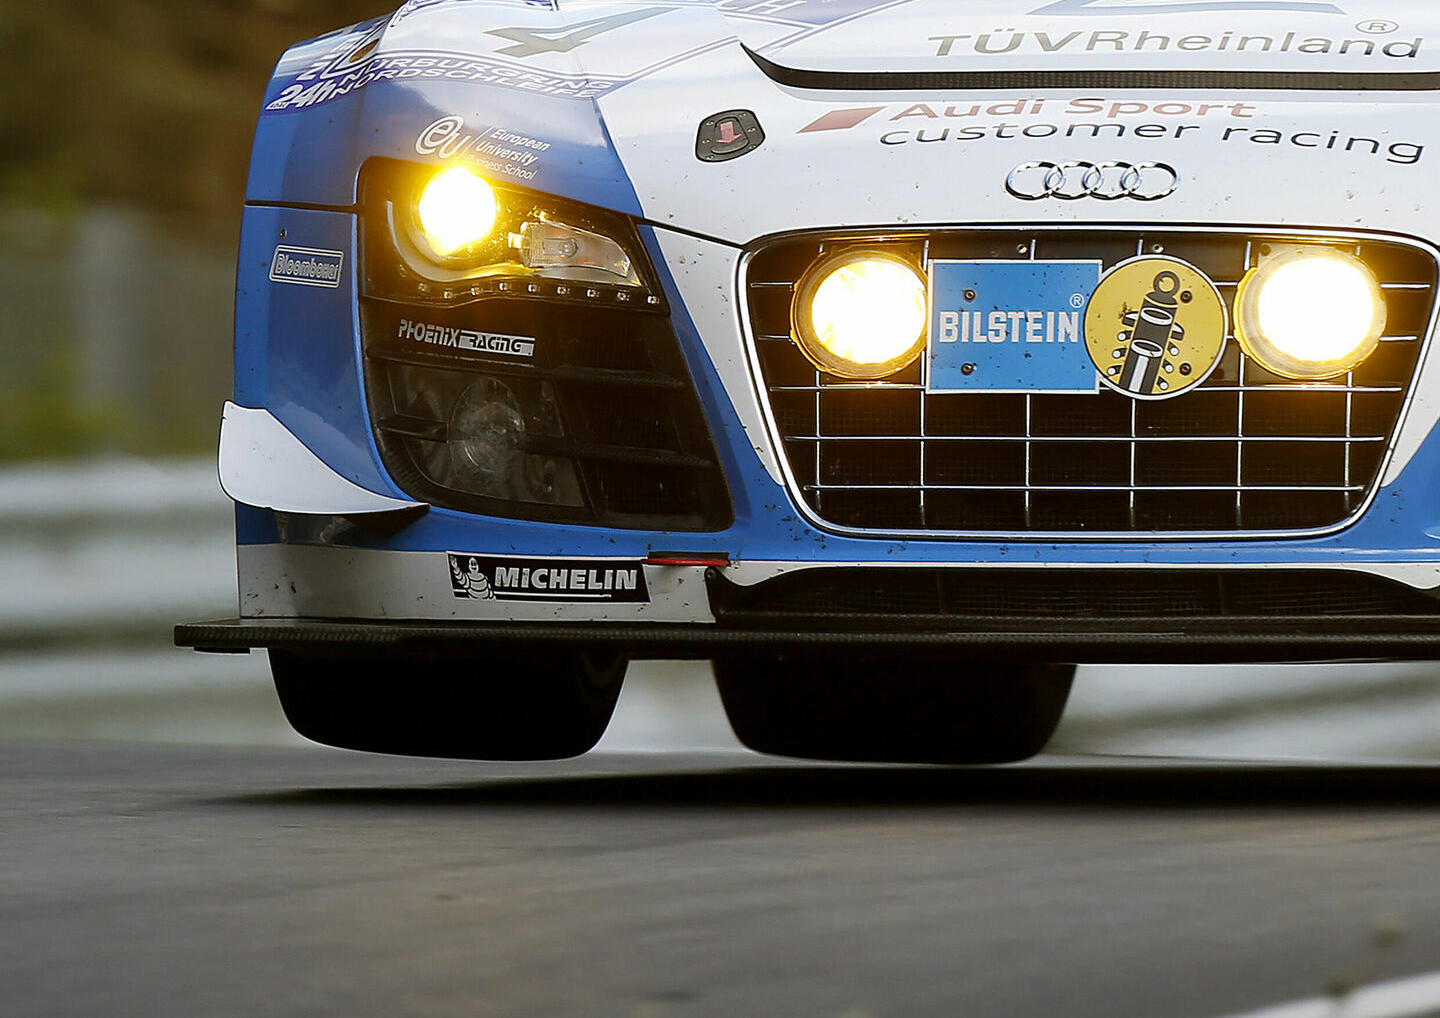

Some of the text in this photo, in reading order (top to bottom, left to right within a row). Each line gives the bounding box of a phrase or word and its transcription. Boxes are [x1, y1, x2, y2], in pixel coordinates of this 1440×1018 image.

[927, 28, 1424, 59] TÜVRheinland
[266, 80, 337, 110] 24h
[329, 68, 602, 99] NORDSCHLEIFE
[886, 97, 1257, 122] Audi Sport
[475, 140, 539, 167] University
[490, 128, 551, 152] European
[880, 122, 1425, 165] customer racing
[502, 163, 538, 181] School
[938, 310, 1080, 344] BILSTEIN
[494, 566, 638, 590] MICHELIN
